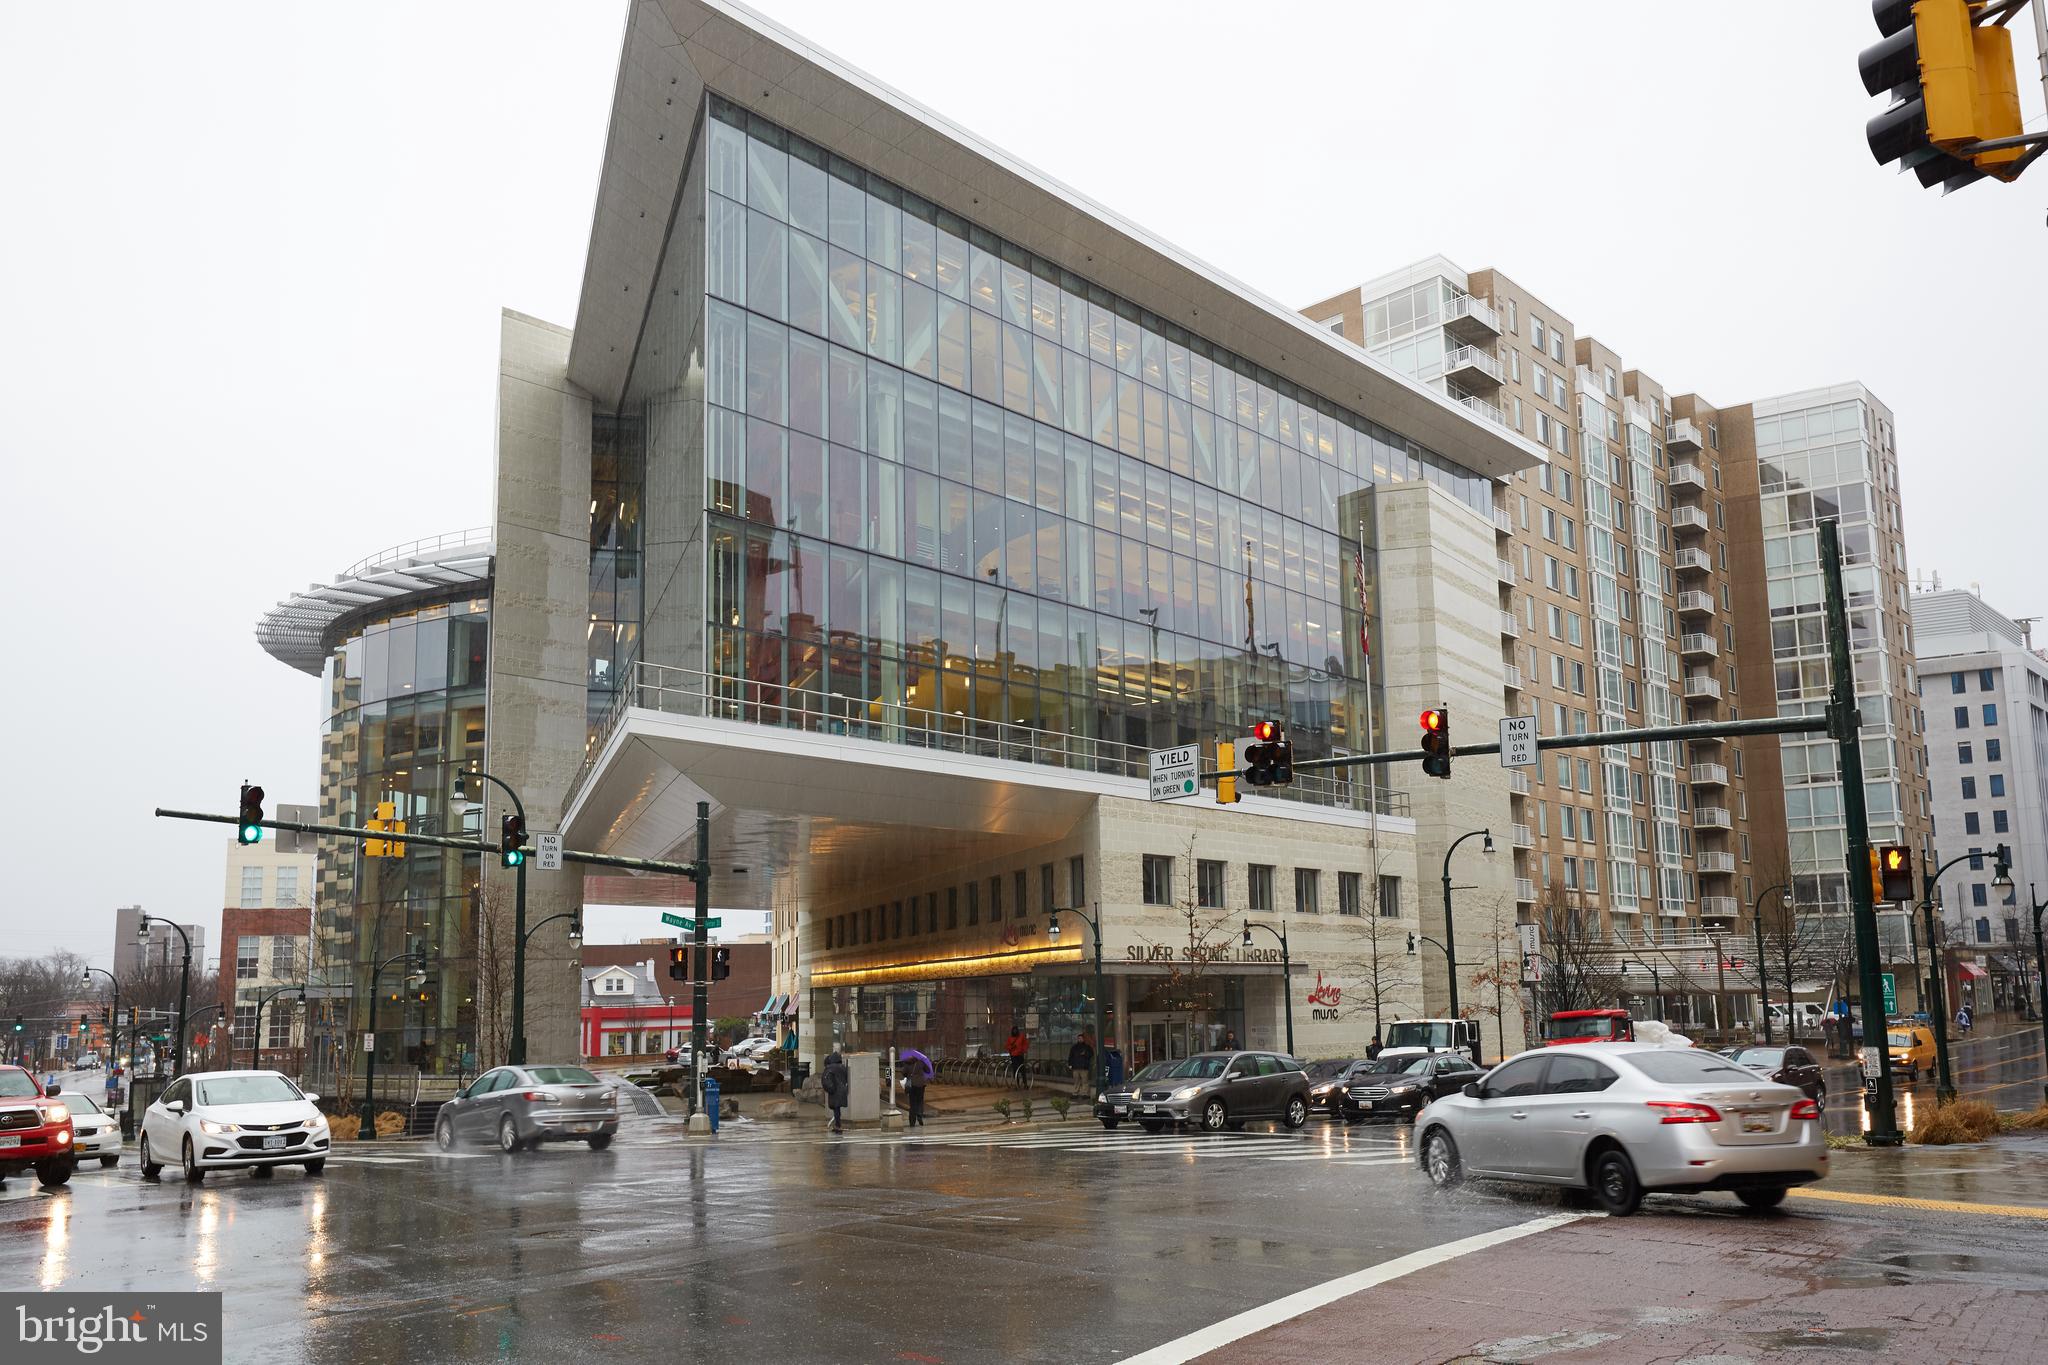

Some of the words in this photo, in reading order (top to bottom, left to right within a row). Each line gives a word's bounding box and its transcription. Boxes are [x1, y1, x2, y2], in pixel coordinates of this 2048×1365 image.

[1509, 720, 1526, 731] NO
[1508, 732, 1529, 742] TURN
[1512, 743, 1525, 752] ON
[1160, 751, 1190, 766] YIELD
[1511, 753, 1527, 763] RED
[1152, 773, 1168, 784] WHEN
[1171, 769, 1195, 781] TURNING
[1152, 787, 1161, 797] ON
[1162, 784, 1181, 795] GREEN
[544, 836, 556, 844] NO
[1126, 945, 1174, 961] SILVER
[1182, 946, 1229, 962] SPRING
[1236, 948, 1284, 962] LIBRARY
[1308, 970, 1341, 1006] Levine
[1312, 1008, 1339, 1021] music
